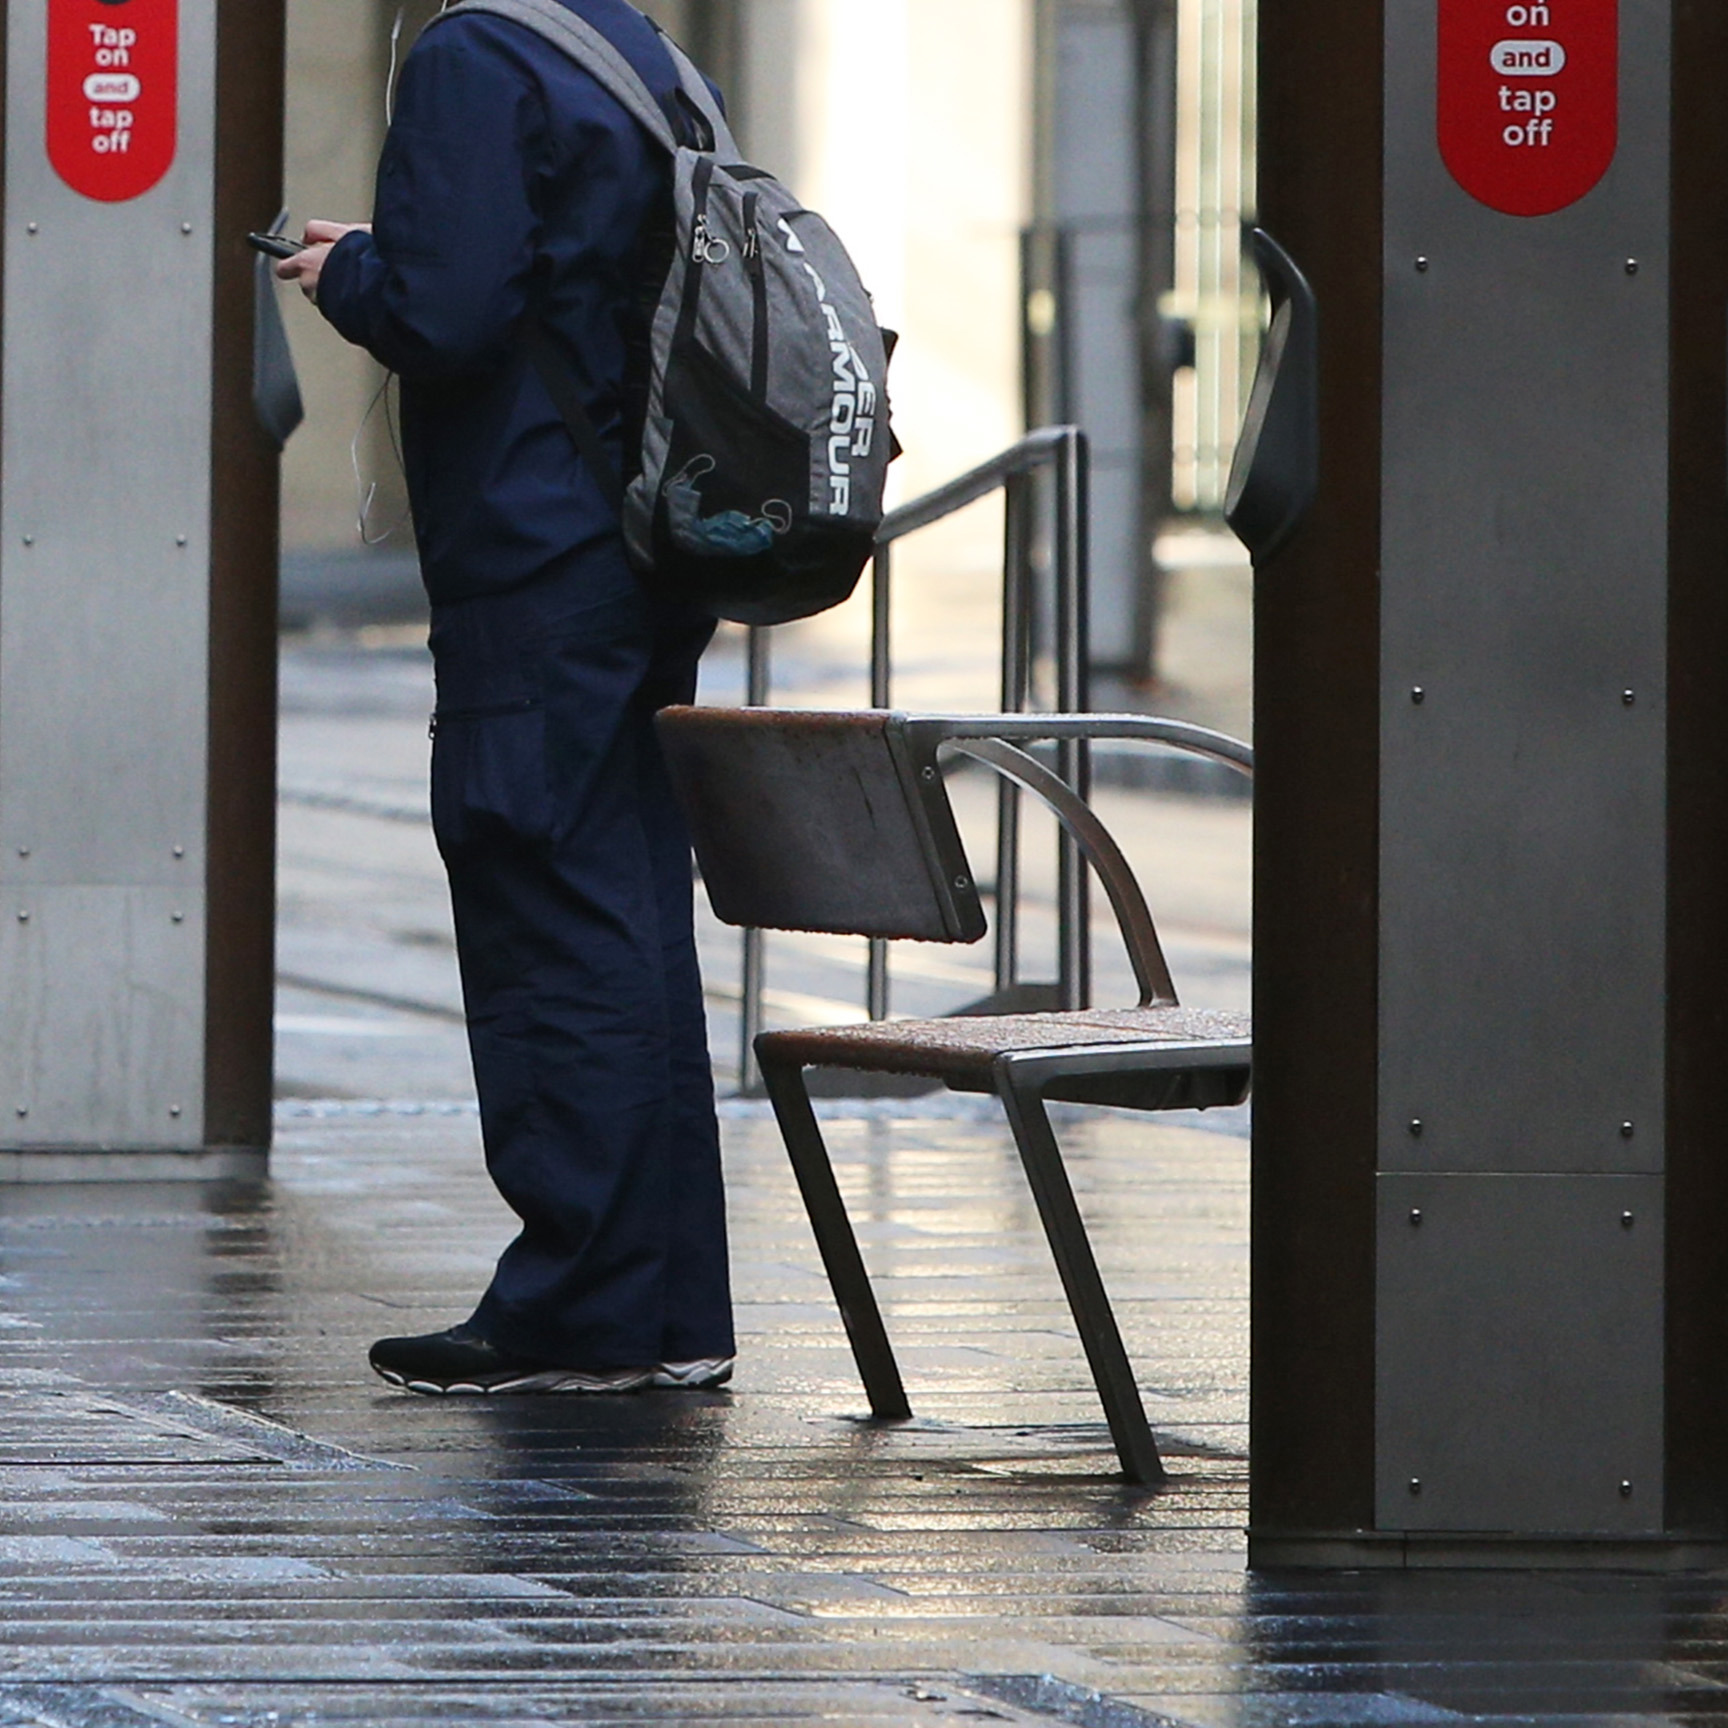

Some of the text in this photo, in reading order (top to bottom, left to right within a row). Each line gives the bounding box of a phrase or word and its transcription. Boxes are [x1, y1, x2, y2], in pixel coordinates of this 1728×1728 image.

[1505, 4, 1550, 27] on
[88, 23, 136, 49] Tap
[94, 48, 130, 67] on
[1501, 47, 1552, 68] and
[93, 79, 130, 94] and
[1497, 83, 1557, 116] tap
[89, 105, 134, 132] tap
[91, 129, 131, 154] off
[1502, 118, 1554, 148] off
[803, 260, 856, 516] ARMOUR
